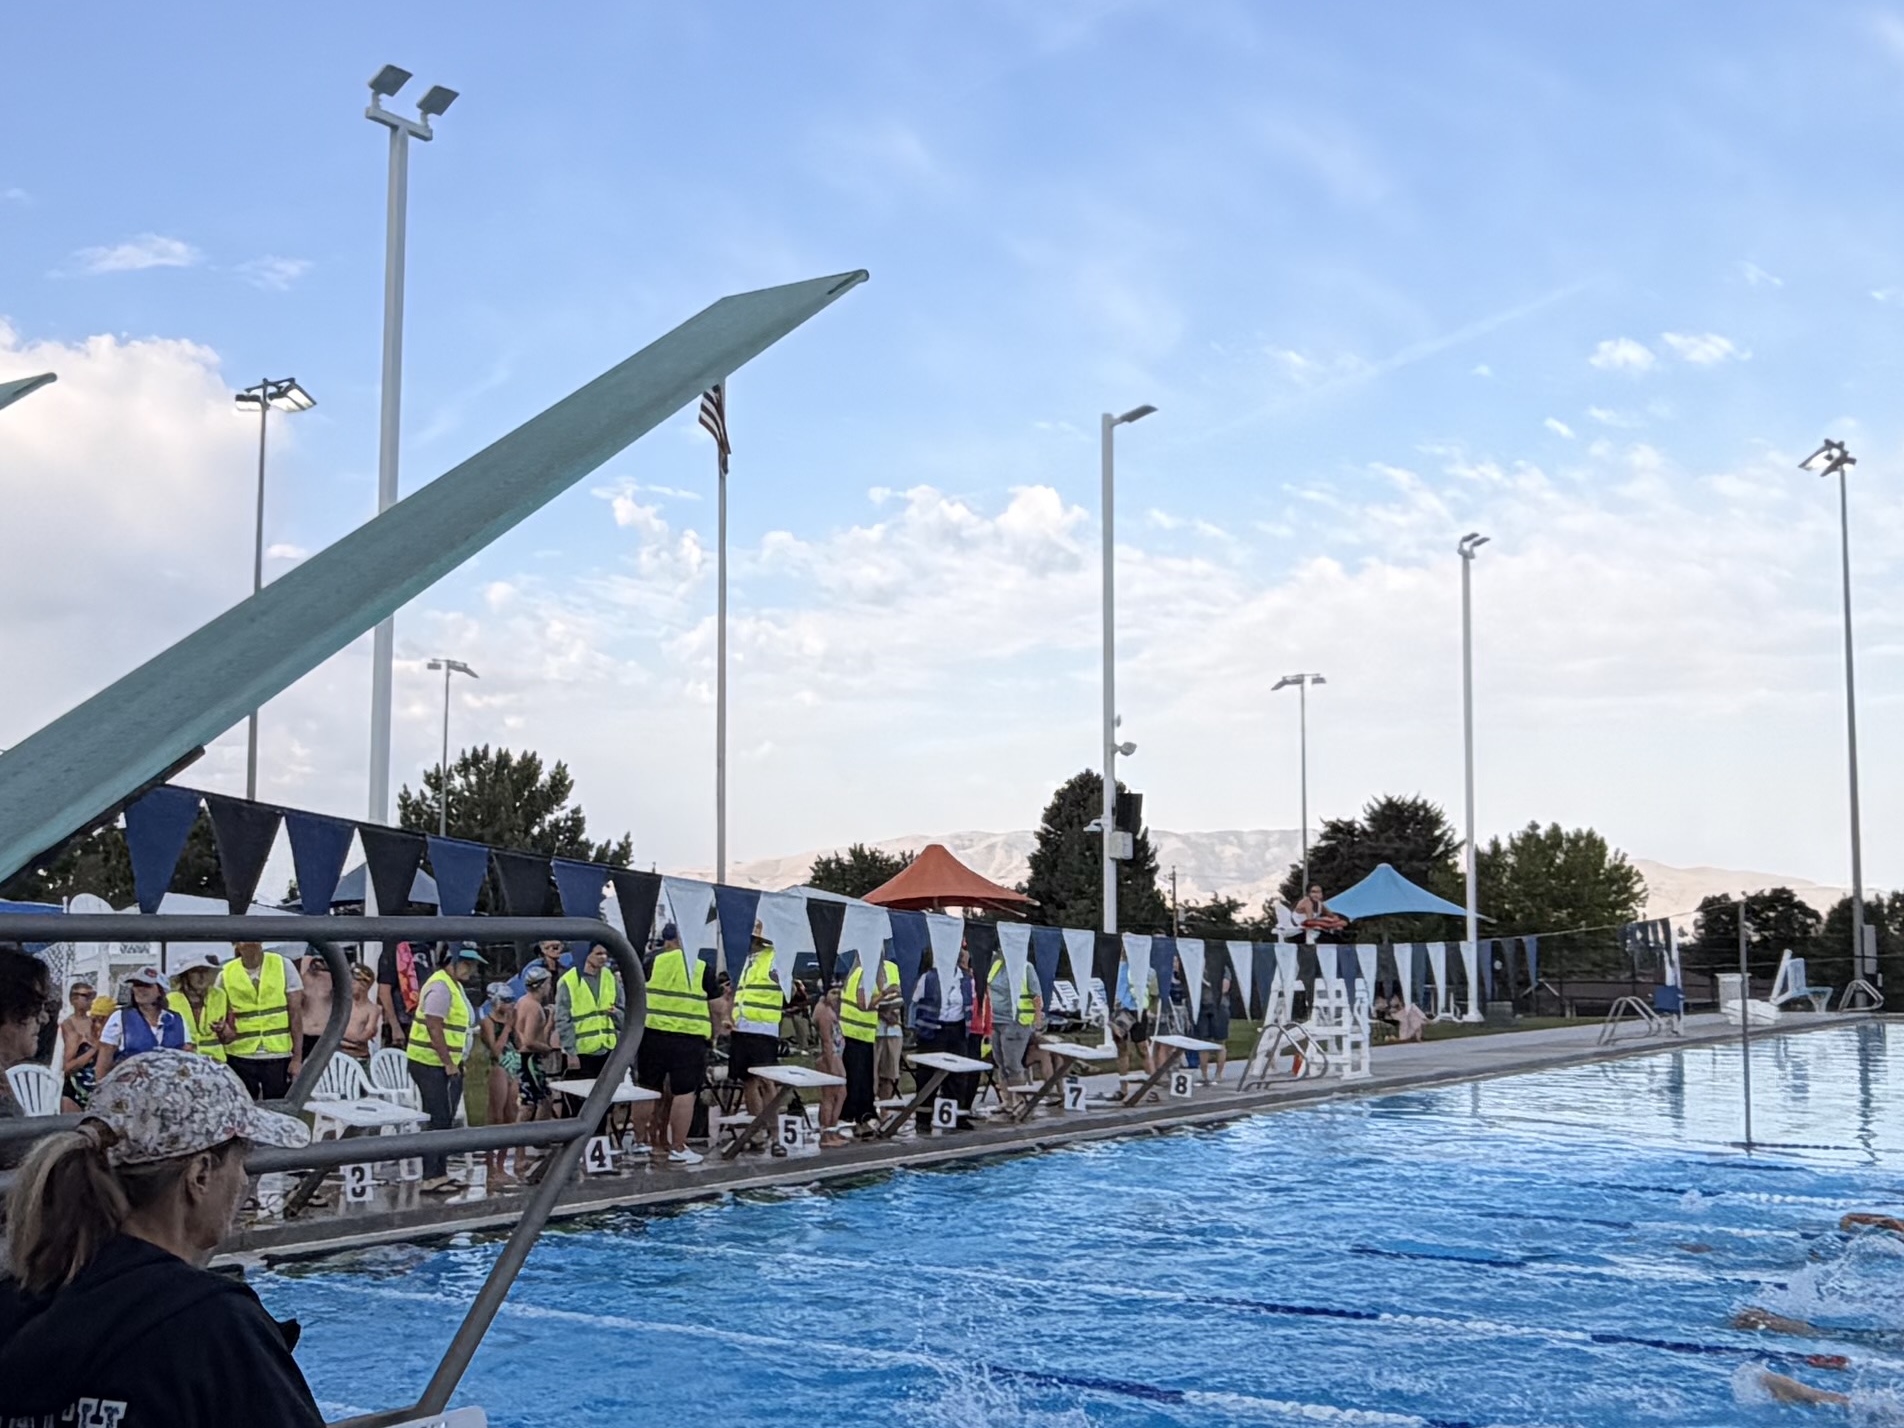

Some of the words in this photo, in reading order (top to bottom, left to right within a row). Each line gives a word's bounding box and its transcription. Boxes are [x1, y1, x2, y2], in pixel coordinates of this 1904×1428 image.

[1175, 1074, 1188, 1095] 8
[1069, 1086, 1083, 1108] 7
[938, 1101, 953, 1125] 6
[783, 1119, 798, 1145] 5
[590, 1139, 608, 1169] 4
